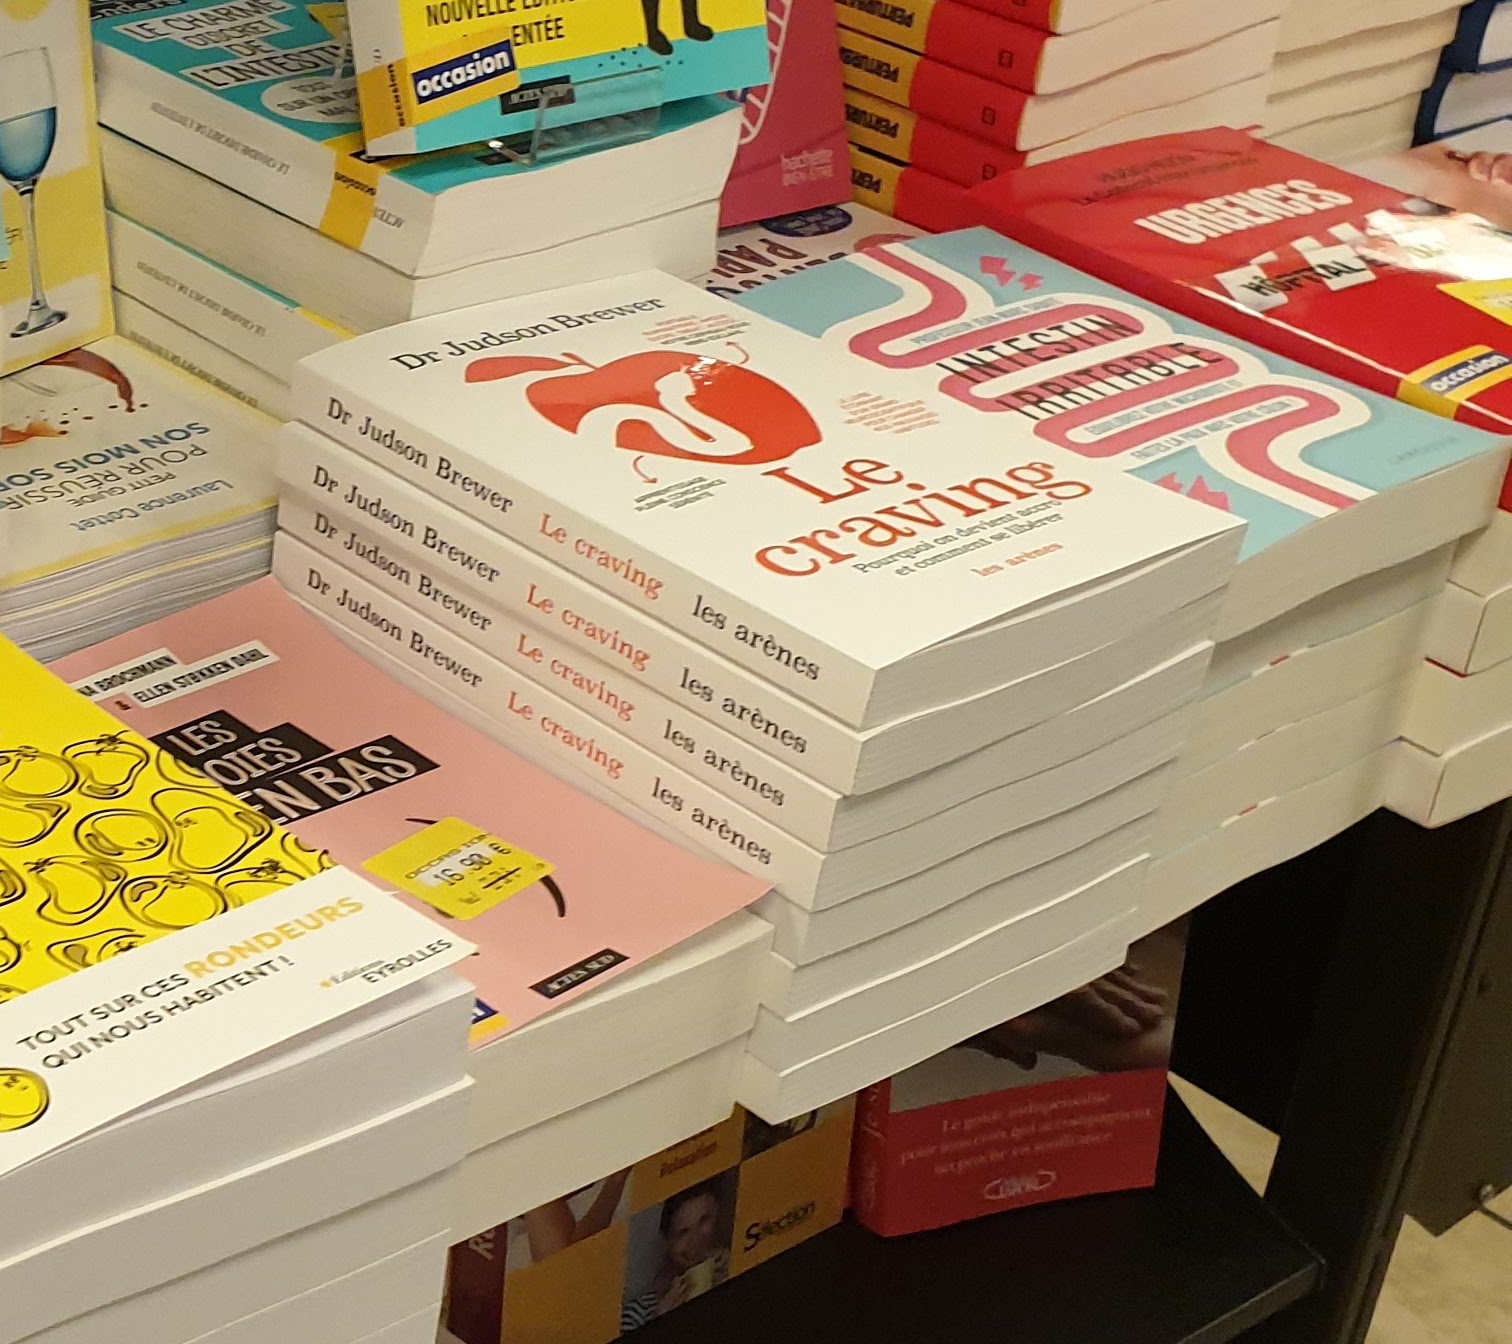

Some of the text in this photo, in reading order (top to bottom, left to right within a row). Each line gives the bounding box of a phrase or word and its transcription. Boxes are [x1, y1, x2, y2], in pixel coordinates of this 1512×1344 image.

[416, 49, 511, 99] occasion
[1134, 179, 1353, 245] URGENCES
[390, 351, 444, 371] Dr
[448, 325, 551, 362] Judson
[551, 296, 667, 331] Brewer
[935, 314, 1141, 384] INTESTIN
[995, 342, 1224, 420] IRRITABLE
[1430, 354, 1511, 392] occasion
[54, 422, 210, 473] SON MOIS
[328, 397, 514, 514] Dr Judson Brewer
[761, 456, 903, 504] Le
[755, 461, 1093, 577] craving
[853, 500, 1062, 574] Pourquoi on devient accro
[896, 512, 1064, 577] et comment se libérer
[539, 513, 820, 680] Le craving les arènes
[170, 719, 239, 758] LES
[306, 568, 771, 865] Dr Judson Brewer Le craving les arènes
[234, 745, 417, 825] EN BAS
[16, 896, 364, 1051] TOUT SUR CES RONDEURS
[362, 938, 453, 985] EYROLLES
[41, 1038, 93, 1070] QUI
[92, 1008, 163, 1048] NOUS
[161, 961, 281, 1019] HABITENT
